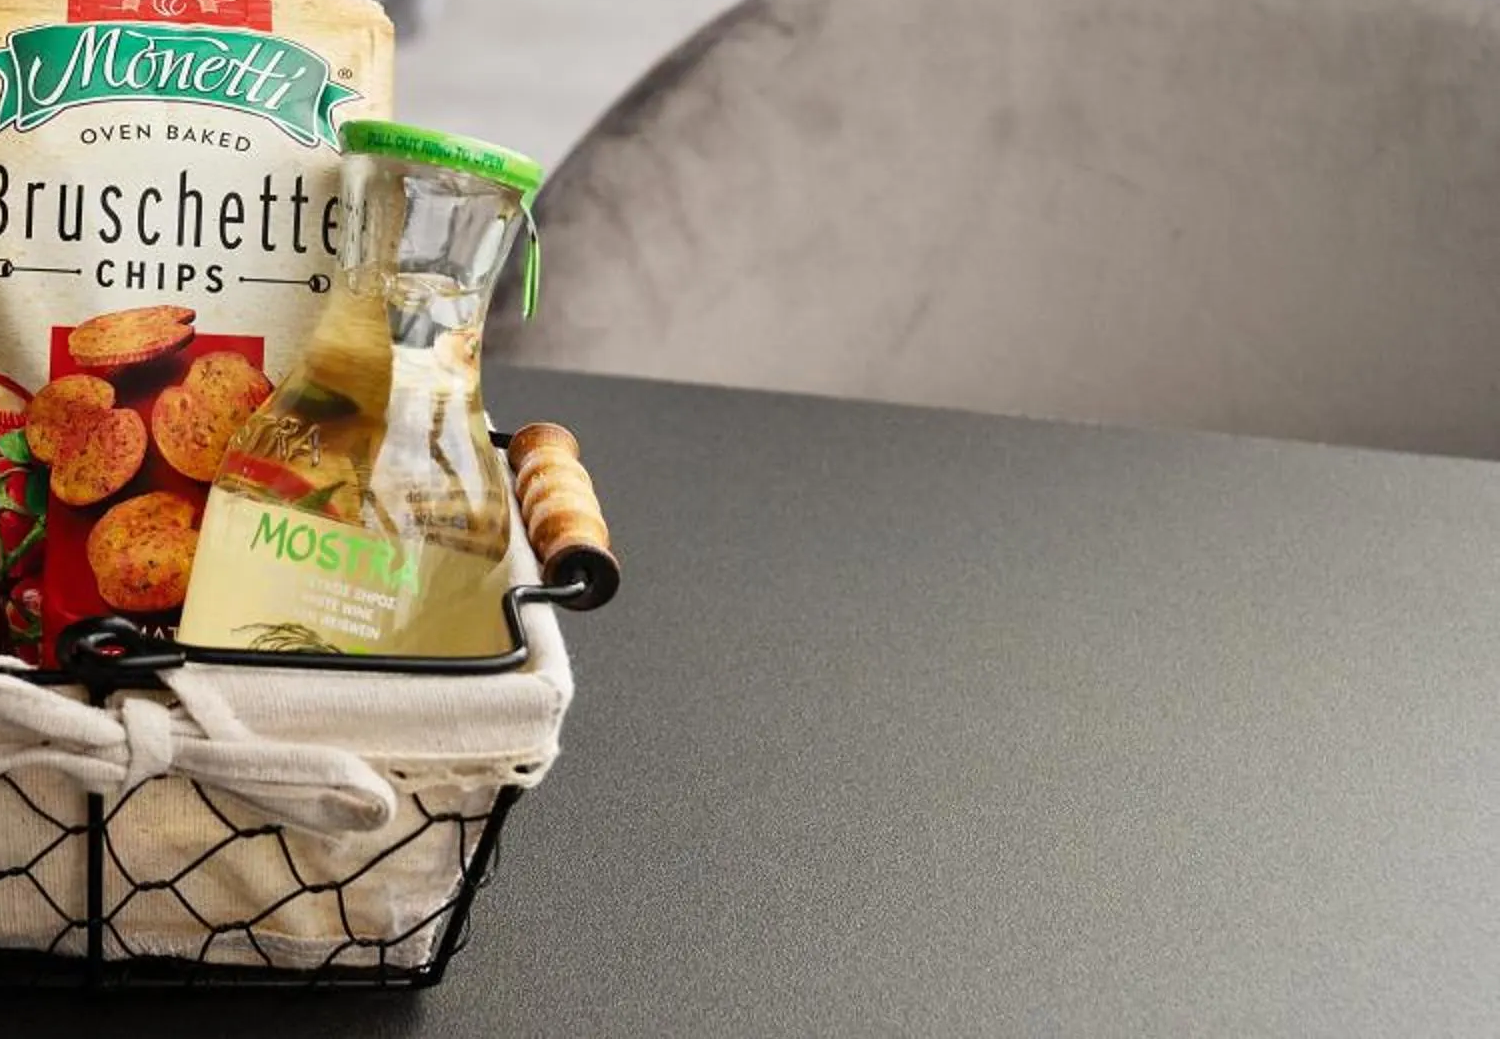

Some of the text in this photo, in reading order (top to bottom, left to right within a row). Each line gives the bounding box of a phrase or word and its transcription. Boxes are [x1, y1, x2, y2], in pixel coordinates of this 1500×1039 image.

[80, 123, 252, 153] OVEN BAKED
[96, 259, 225, 293] CHIPS
[250, 512, 420, 595] MOSTRA
